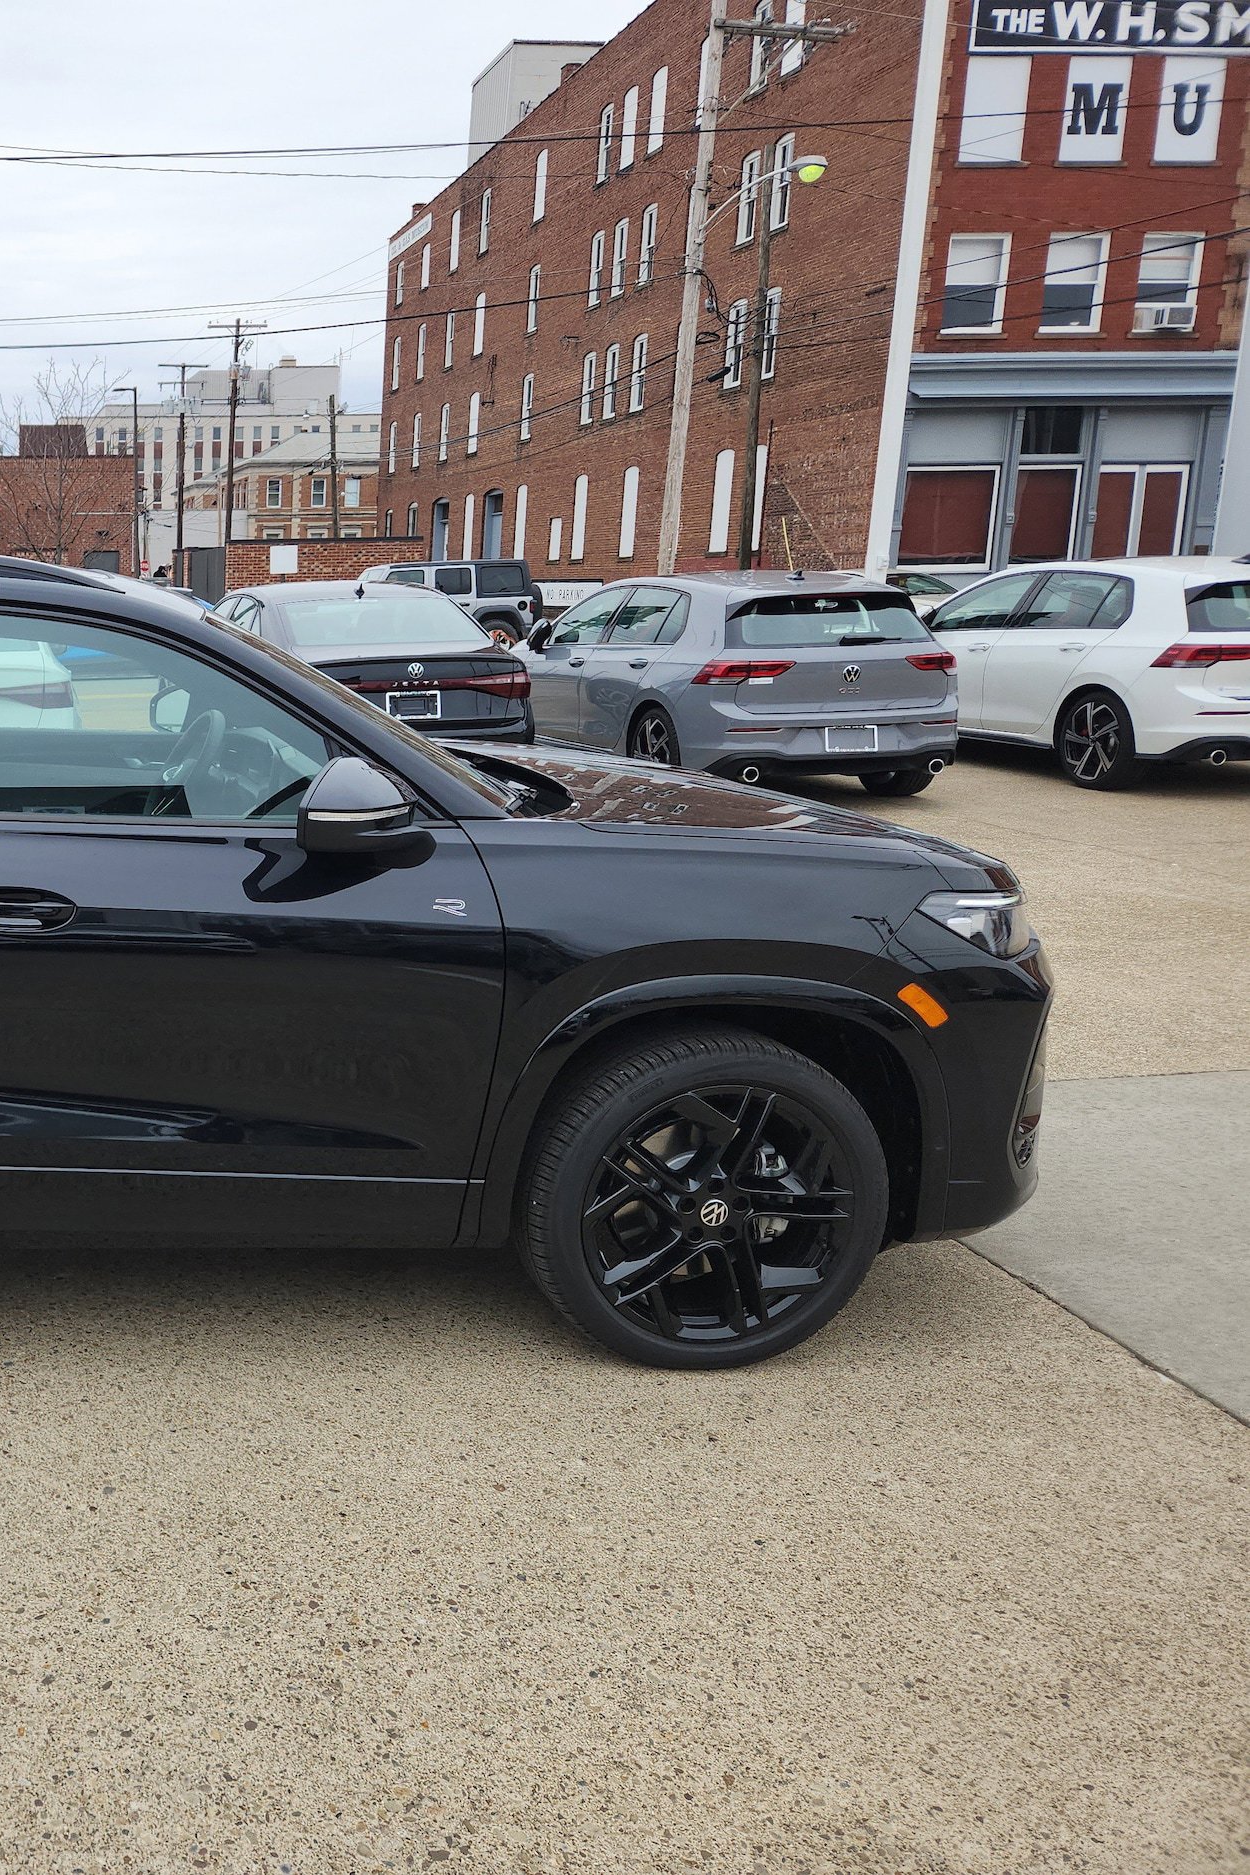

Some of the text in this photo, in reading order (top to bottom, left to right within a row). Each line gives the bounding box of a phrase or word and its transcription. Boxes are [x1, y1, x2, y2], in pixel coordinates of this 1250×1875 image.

[991, 8, 1046, 34] THE
[547, 589, 584, 600] NO PARKING
